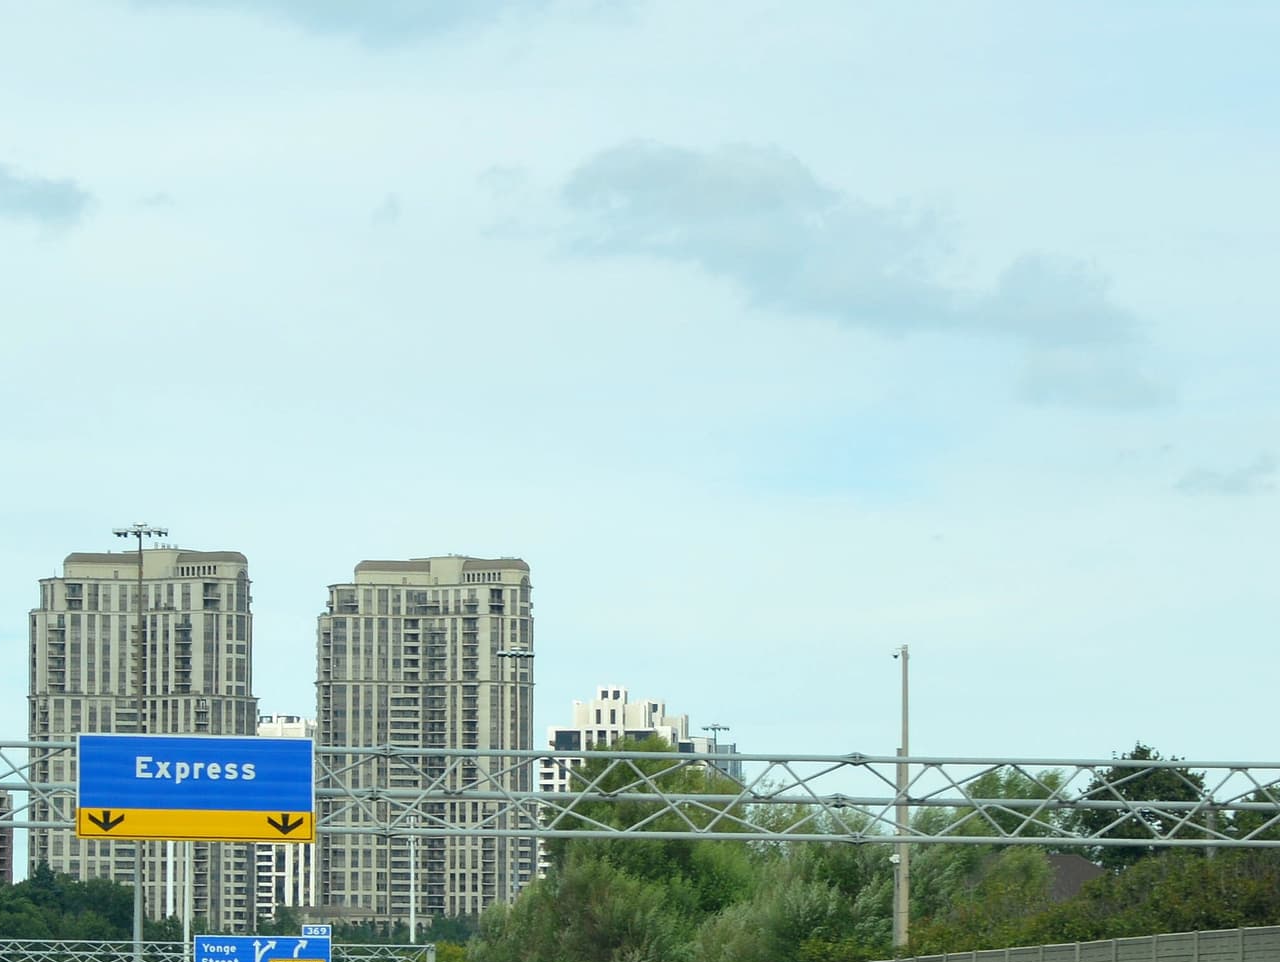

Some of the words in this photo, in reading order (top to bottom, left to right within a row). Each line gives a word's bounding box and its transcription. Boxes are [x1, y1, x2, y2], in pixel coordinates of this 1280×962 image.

[135, 756, 256, 784] Express
[306, 927, 327, 935] 369
[202, 943, 237, 955] Yonge
